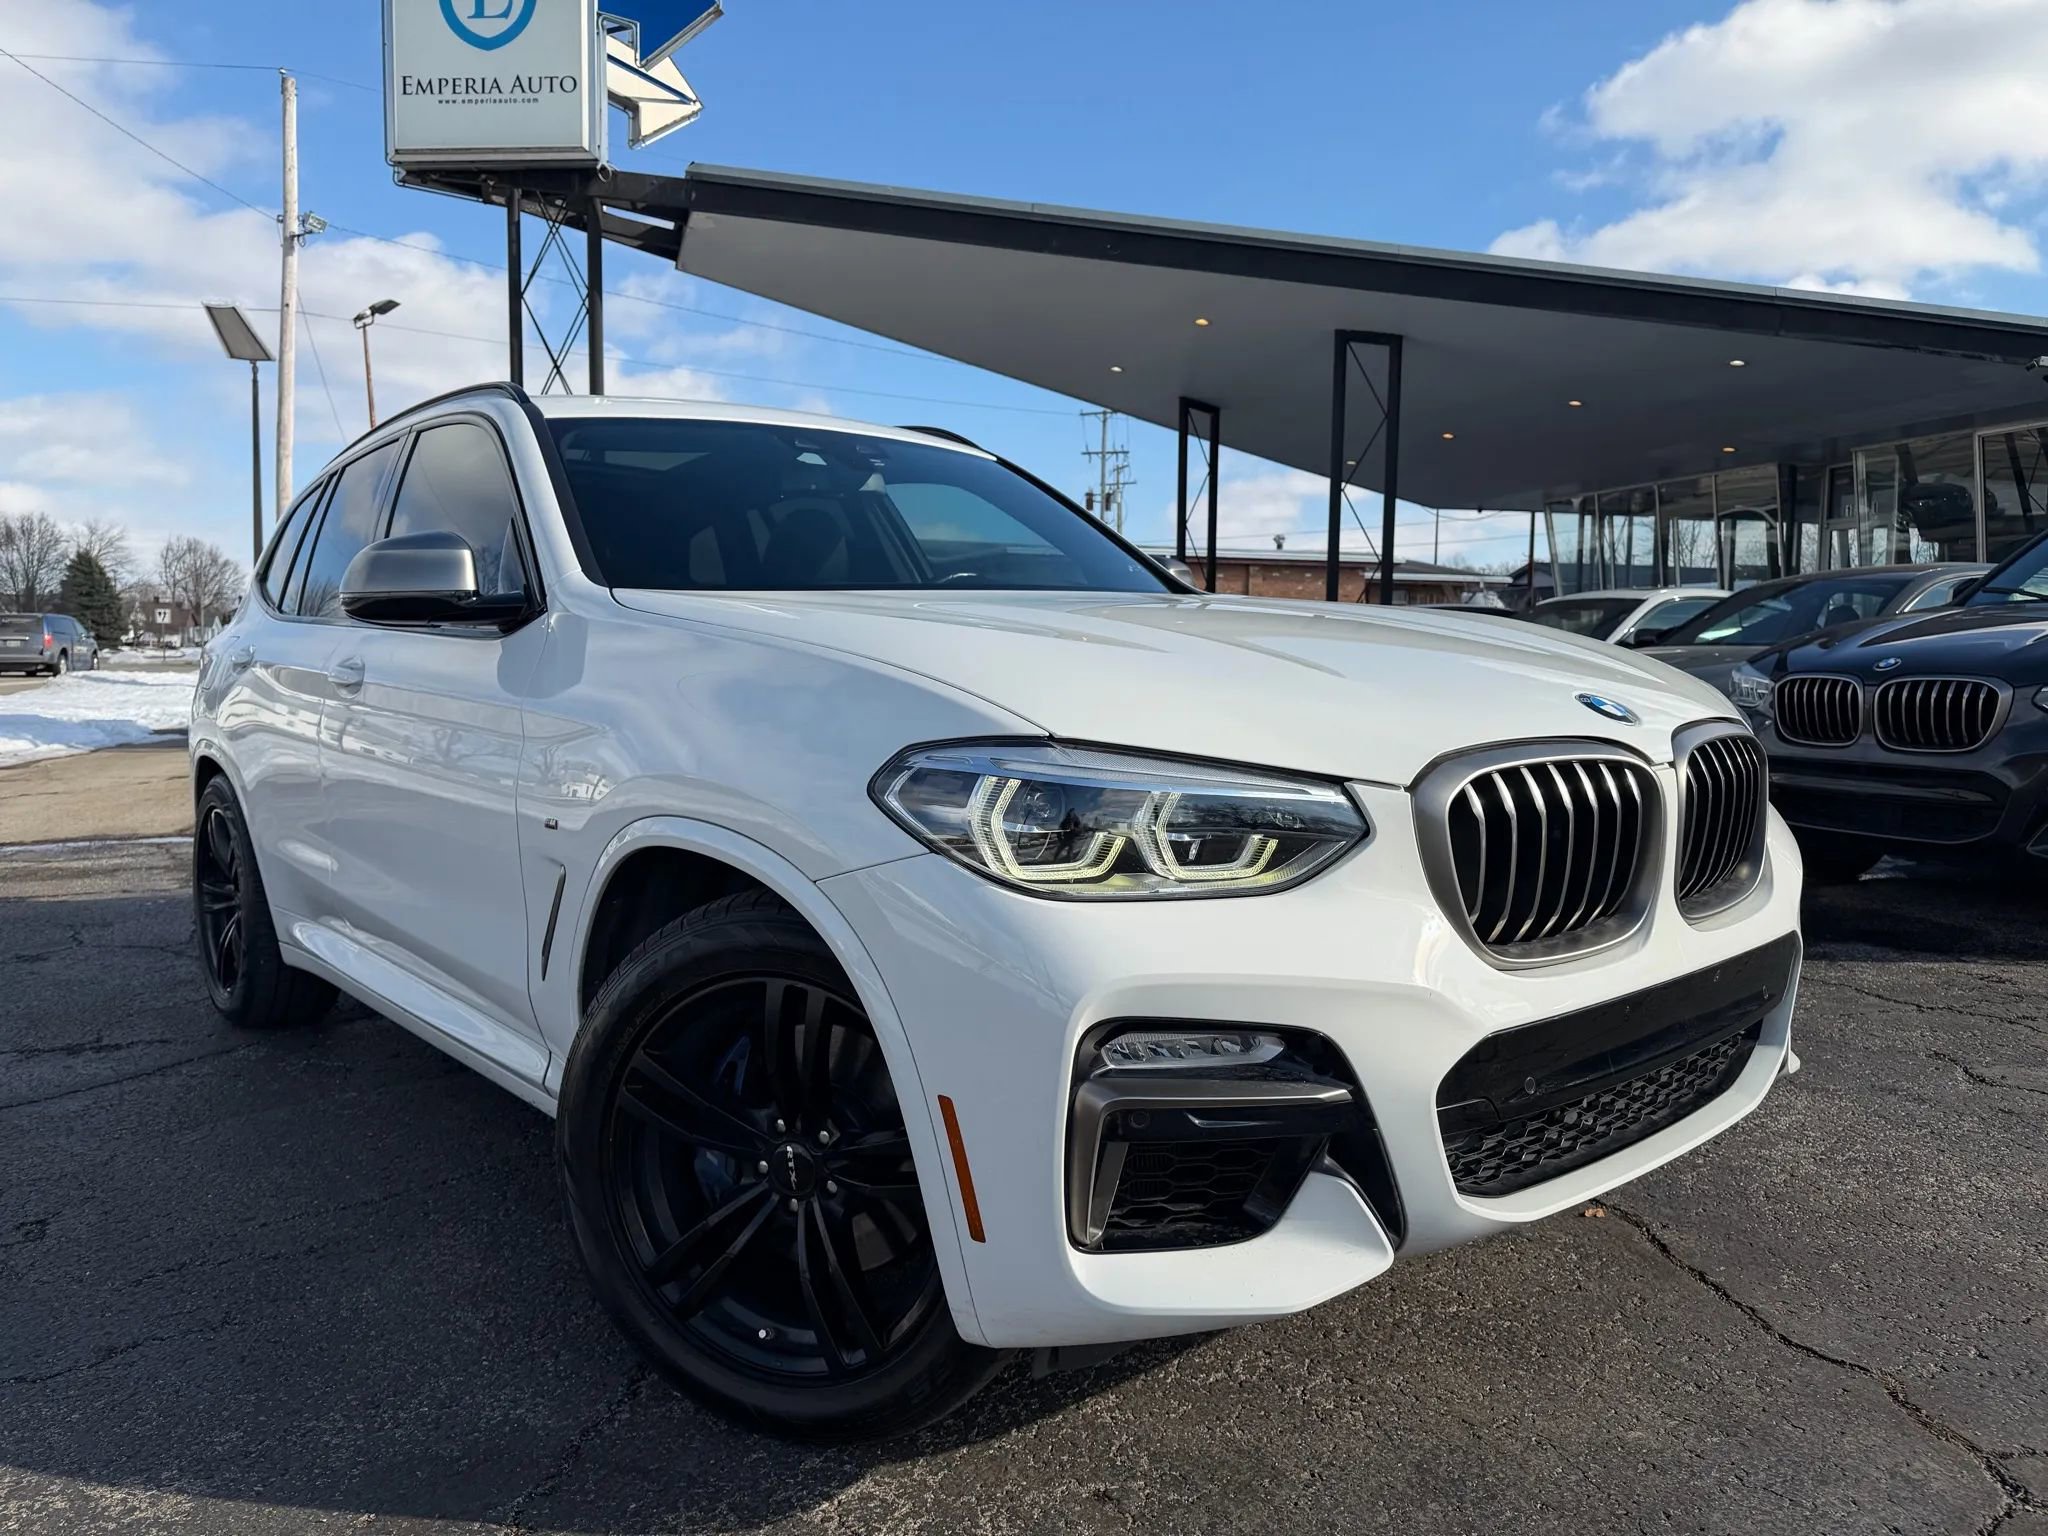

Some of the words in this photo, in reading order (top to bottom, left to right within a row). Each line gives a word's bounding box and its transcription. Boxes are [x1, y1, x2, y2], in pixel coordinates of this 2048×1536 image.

[400, 75, 503, 95] EMPERIA
[509, 73, 578, 94] AUTO
[438, 97, 539, 106] www.emperiaauto.com
[786, 1145, 798, 1190] RTX
